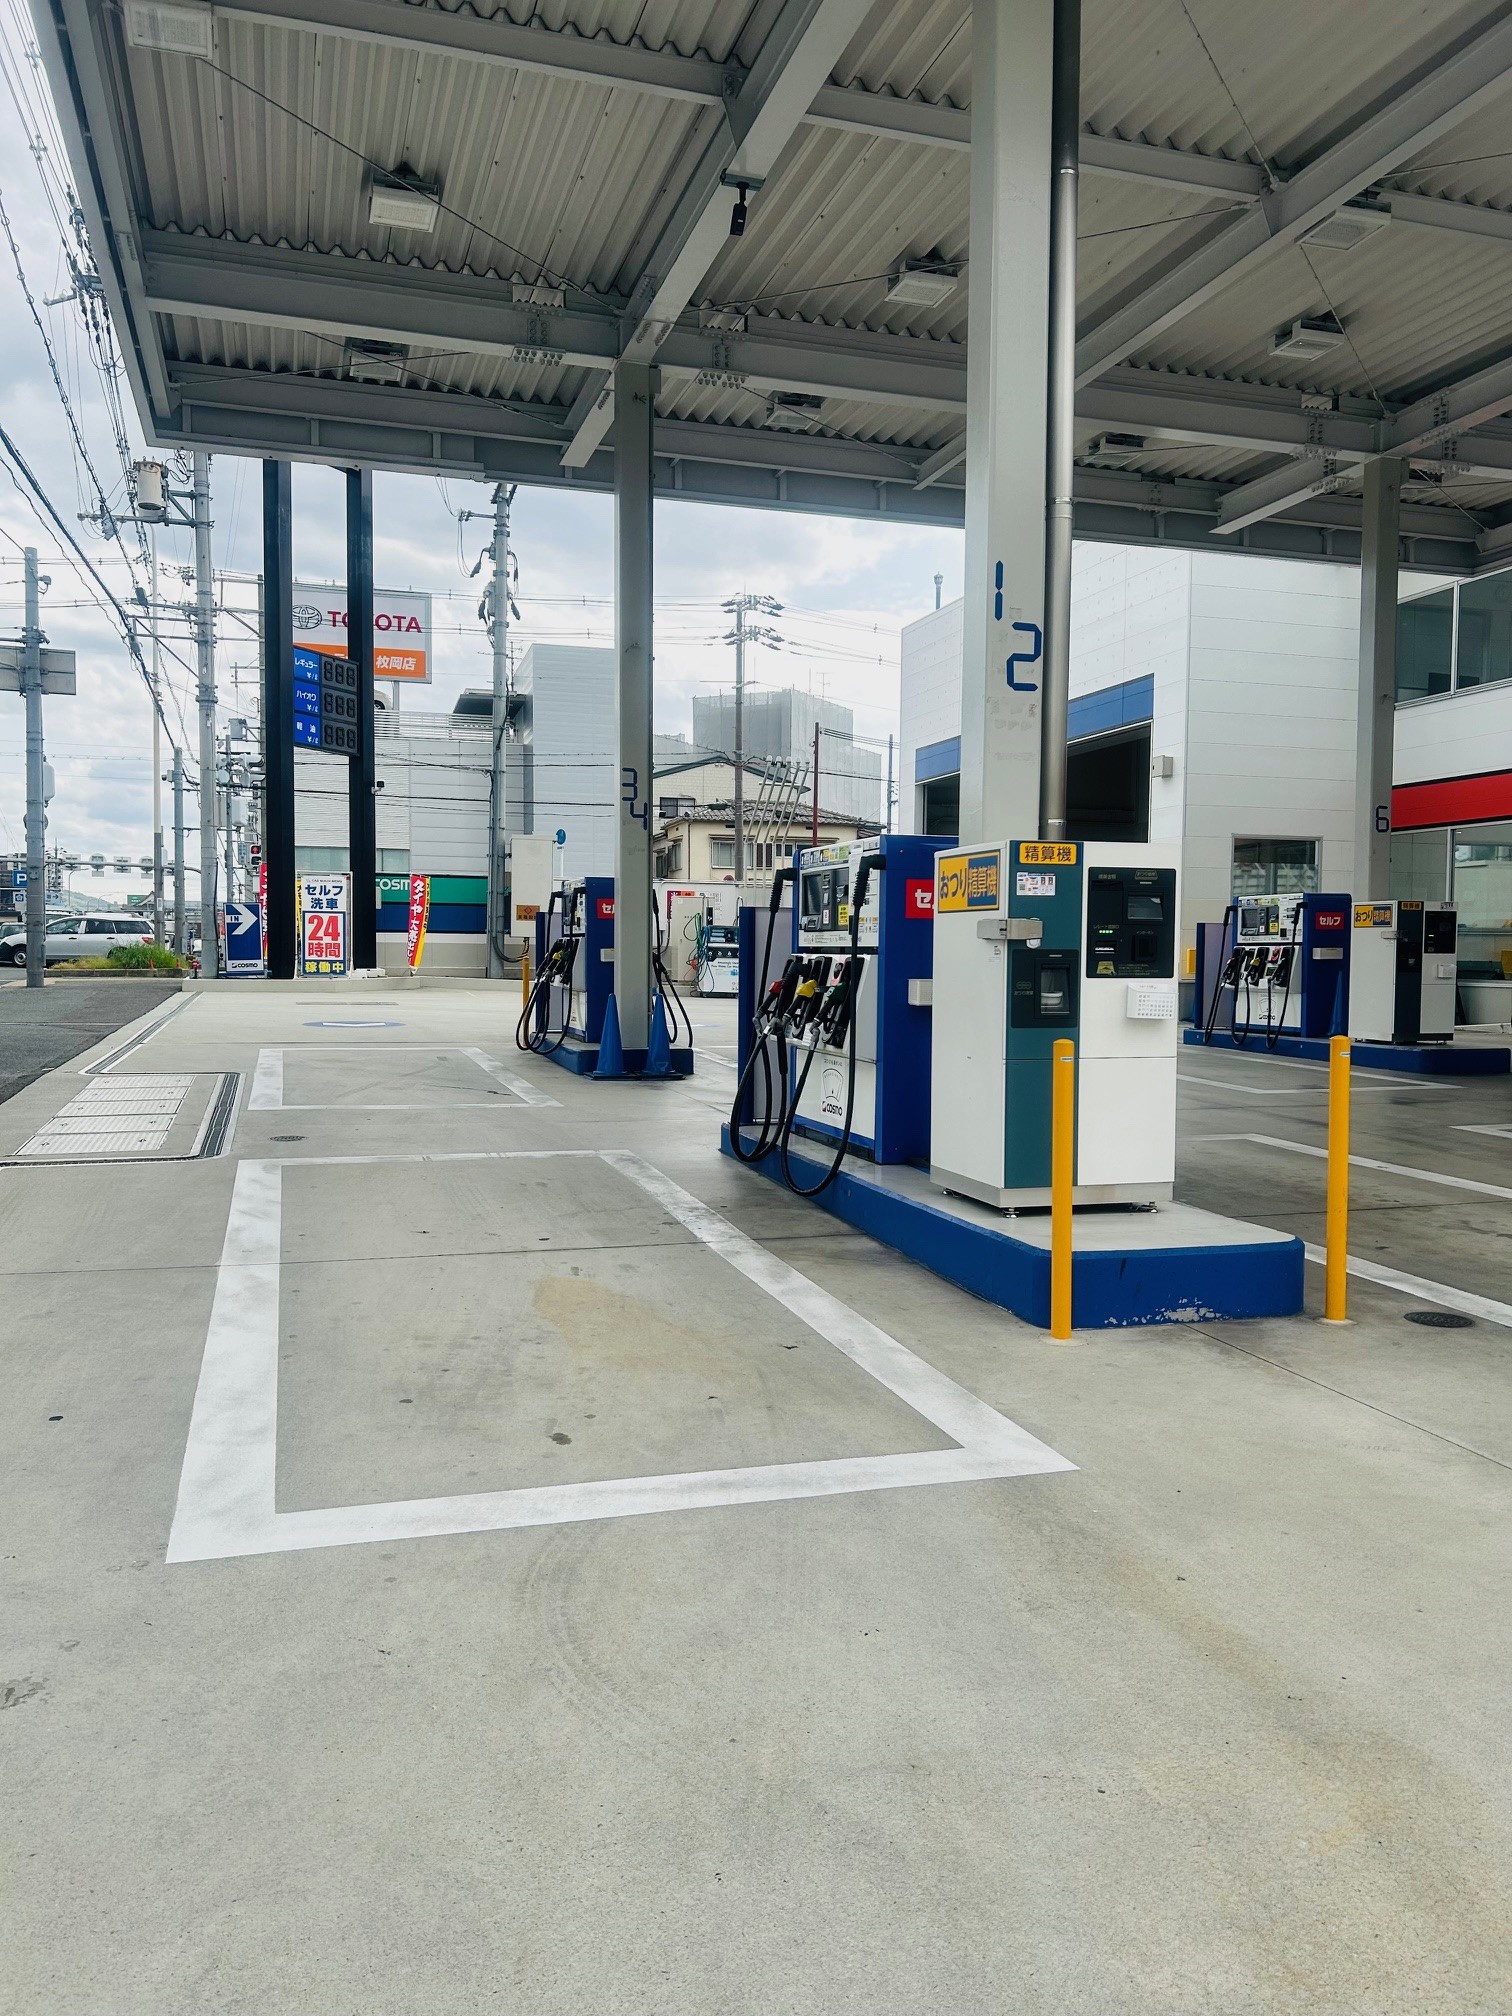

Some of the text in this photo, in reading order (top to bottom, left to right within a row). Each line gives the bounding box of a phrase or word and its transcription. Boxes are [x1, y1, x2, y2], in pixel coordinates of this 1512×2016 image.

[995, 560, 1004, 621] 1
[327, 611, 422, 633] TOTA
[294, 657, 318, 669] レギュラー
[376, 655, 416, 671] 枚岡店
[1006, 621, 1042, 692] 2
[296, 689, 317, 702] ハイオク
[622, 767, 637, 802] 3
[630, 802, 648, 831] 4
[1376, 805, 1390, 833] 6
[1024, 845, 1072, 862] 精算機
[17, 873, 27, 885] P
[376, 879, 410, 890] OSM
[940, 863, 998, 900] おつり精算機
[305, 884, 343, 896] セルフ
[311, 897, 338, 910] 洗車
[308, 914, 340, 941] 24
[1319, 916, 1341, 926] セルフ
[308, 942, 340, 958] 時間
[305, 961, 343, 973] 稼働中
[826, 1102, 843, 1117] COSMO
